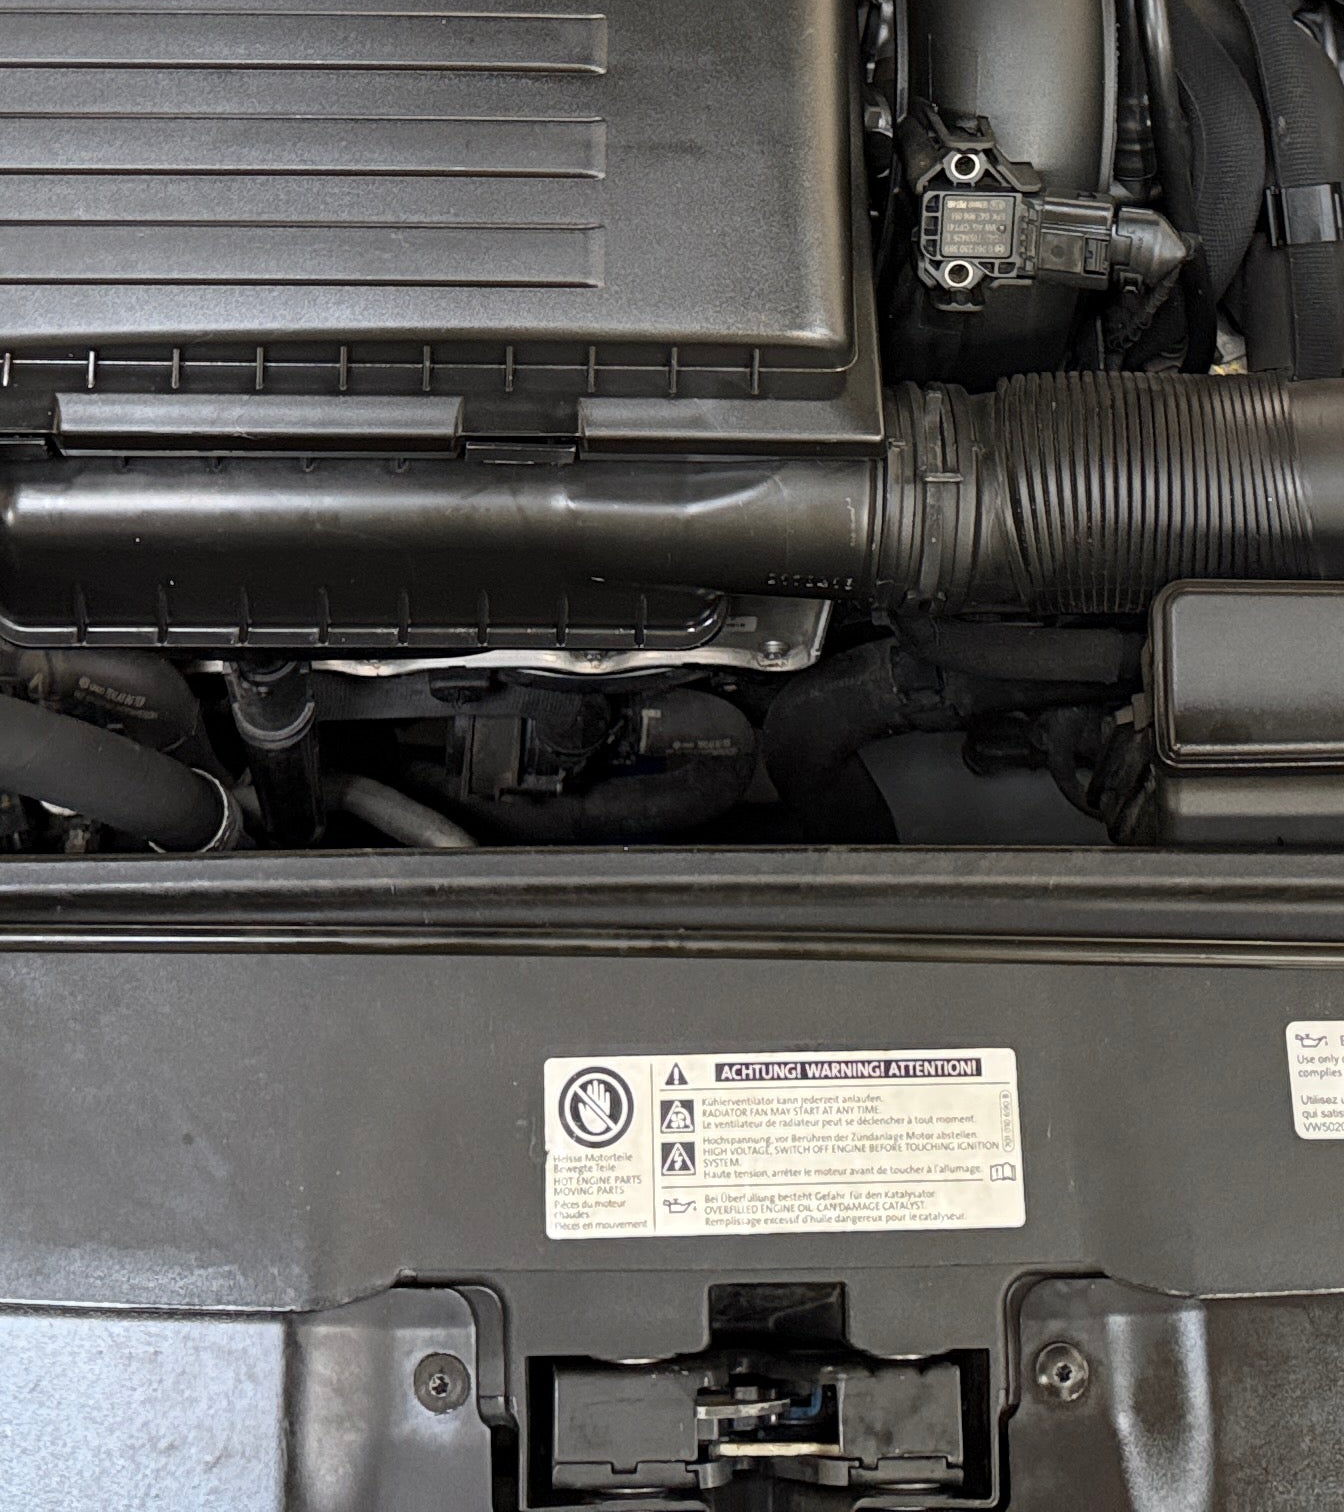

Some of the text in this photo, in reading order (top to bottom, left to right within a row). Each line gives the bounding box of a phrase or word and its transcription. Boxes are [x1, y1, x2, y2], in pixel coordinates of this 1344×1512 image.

[1297, 1055, 1315, 1064] Use
[1318, 1055, 1339, 1066] only
[721, 1060, 977, 1080] ACHTUNG! WARNING! ATTENTION!
[1298, 1068, 1342, 1079] complies
[777, 1096, 798, 1105] kann
[1301, 1095, 1337, 1105] Utilisez
[702, 1108, 748, 1117] RADIATOR
[750, 1108, 768, 1117] FAN
[770, 1107, 791, 1116] MAY
[793, 1106, 820, 1116] START
[822, 1106, 833, 1115] AT
[836, 1106, 854, 1115] ANY
[1302, 1109, 1317, 1119] qui
[702, 1120, 712, 1129] Le
[714, 1119, 762, 1129] ventilateur
[766, 1118, 776, 1128] de
[779, 1118, 819, 1127] radiateur
[822, 1117, 842, 1128] peut
[845, 1118, 854, 1126] se
[915, 1115, 934, 1124] tout
[834, 1134, 848, 1142] der
[906, 1132, 934, 1140] Motor
[703, 1147, 727, 1156] HIGH
[775, 1145, 810, 1155] SWITCH
[812, 1145, 829, 1154] OFF
[832, 1144, 866, 1154] ENGINE
[869, 1143, 902, 1152] BEFORE
[906, 1142, 955, 1152] TOUCHING
[957, 1141, 1000, 1151] IGNITION
[585, 1153, 633, 1162] Motorteile
[595, 1163, 616, 1172] Teile
[704, 1170, 731, 1179] Haute
[804, 1168, 812, 1176] le
[814, 1168, 848, 1176] moteur
[850, 1167, 874, 1175] avant
[877, 1166, 888, 1175] de
[890, 1166, 924, 1174] toucher
[553, 1175, 642, 1186] HOT ENGINE PARTS
[554, 1186, 624, 1196] MOVING PARTS
[705, 1194, 718, 1203] Bei
[778, 1192, 811, 1201] besteht
[814, 1191, 845, 1201] Gefahr
[865, 1190, 882, 1199] den
[582, 1200, 593, 1208] du
[595, 1200, 626, 1208] moteur
[704, 1205, 758, 1215] OVERFILLED
[761, 1204, 795, 1214] ENGINE
[797, 1204, 813, 1213] OIL
[839, 1202, 880, 1212] DAMAGE
[583, 1222, 593, 1230] en
[705, 1217, 761, 1227] Remplissage
[764, 1215, 800, 1225] excessif
[834, 1214, 883, 1226] dangereux
[886, 1214, 906, 1223] pour
